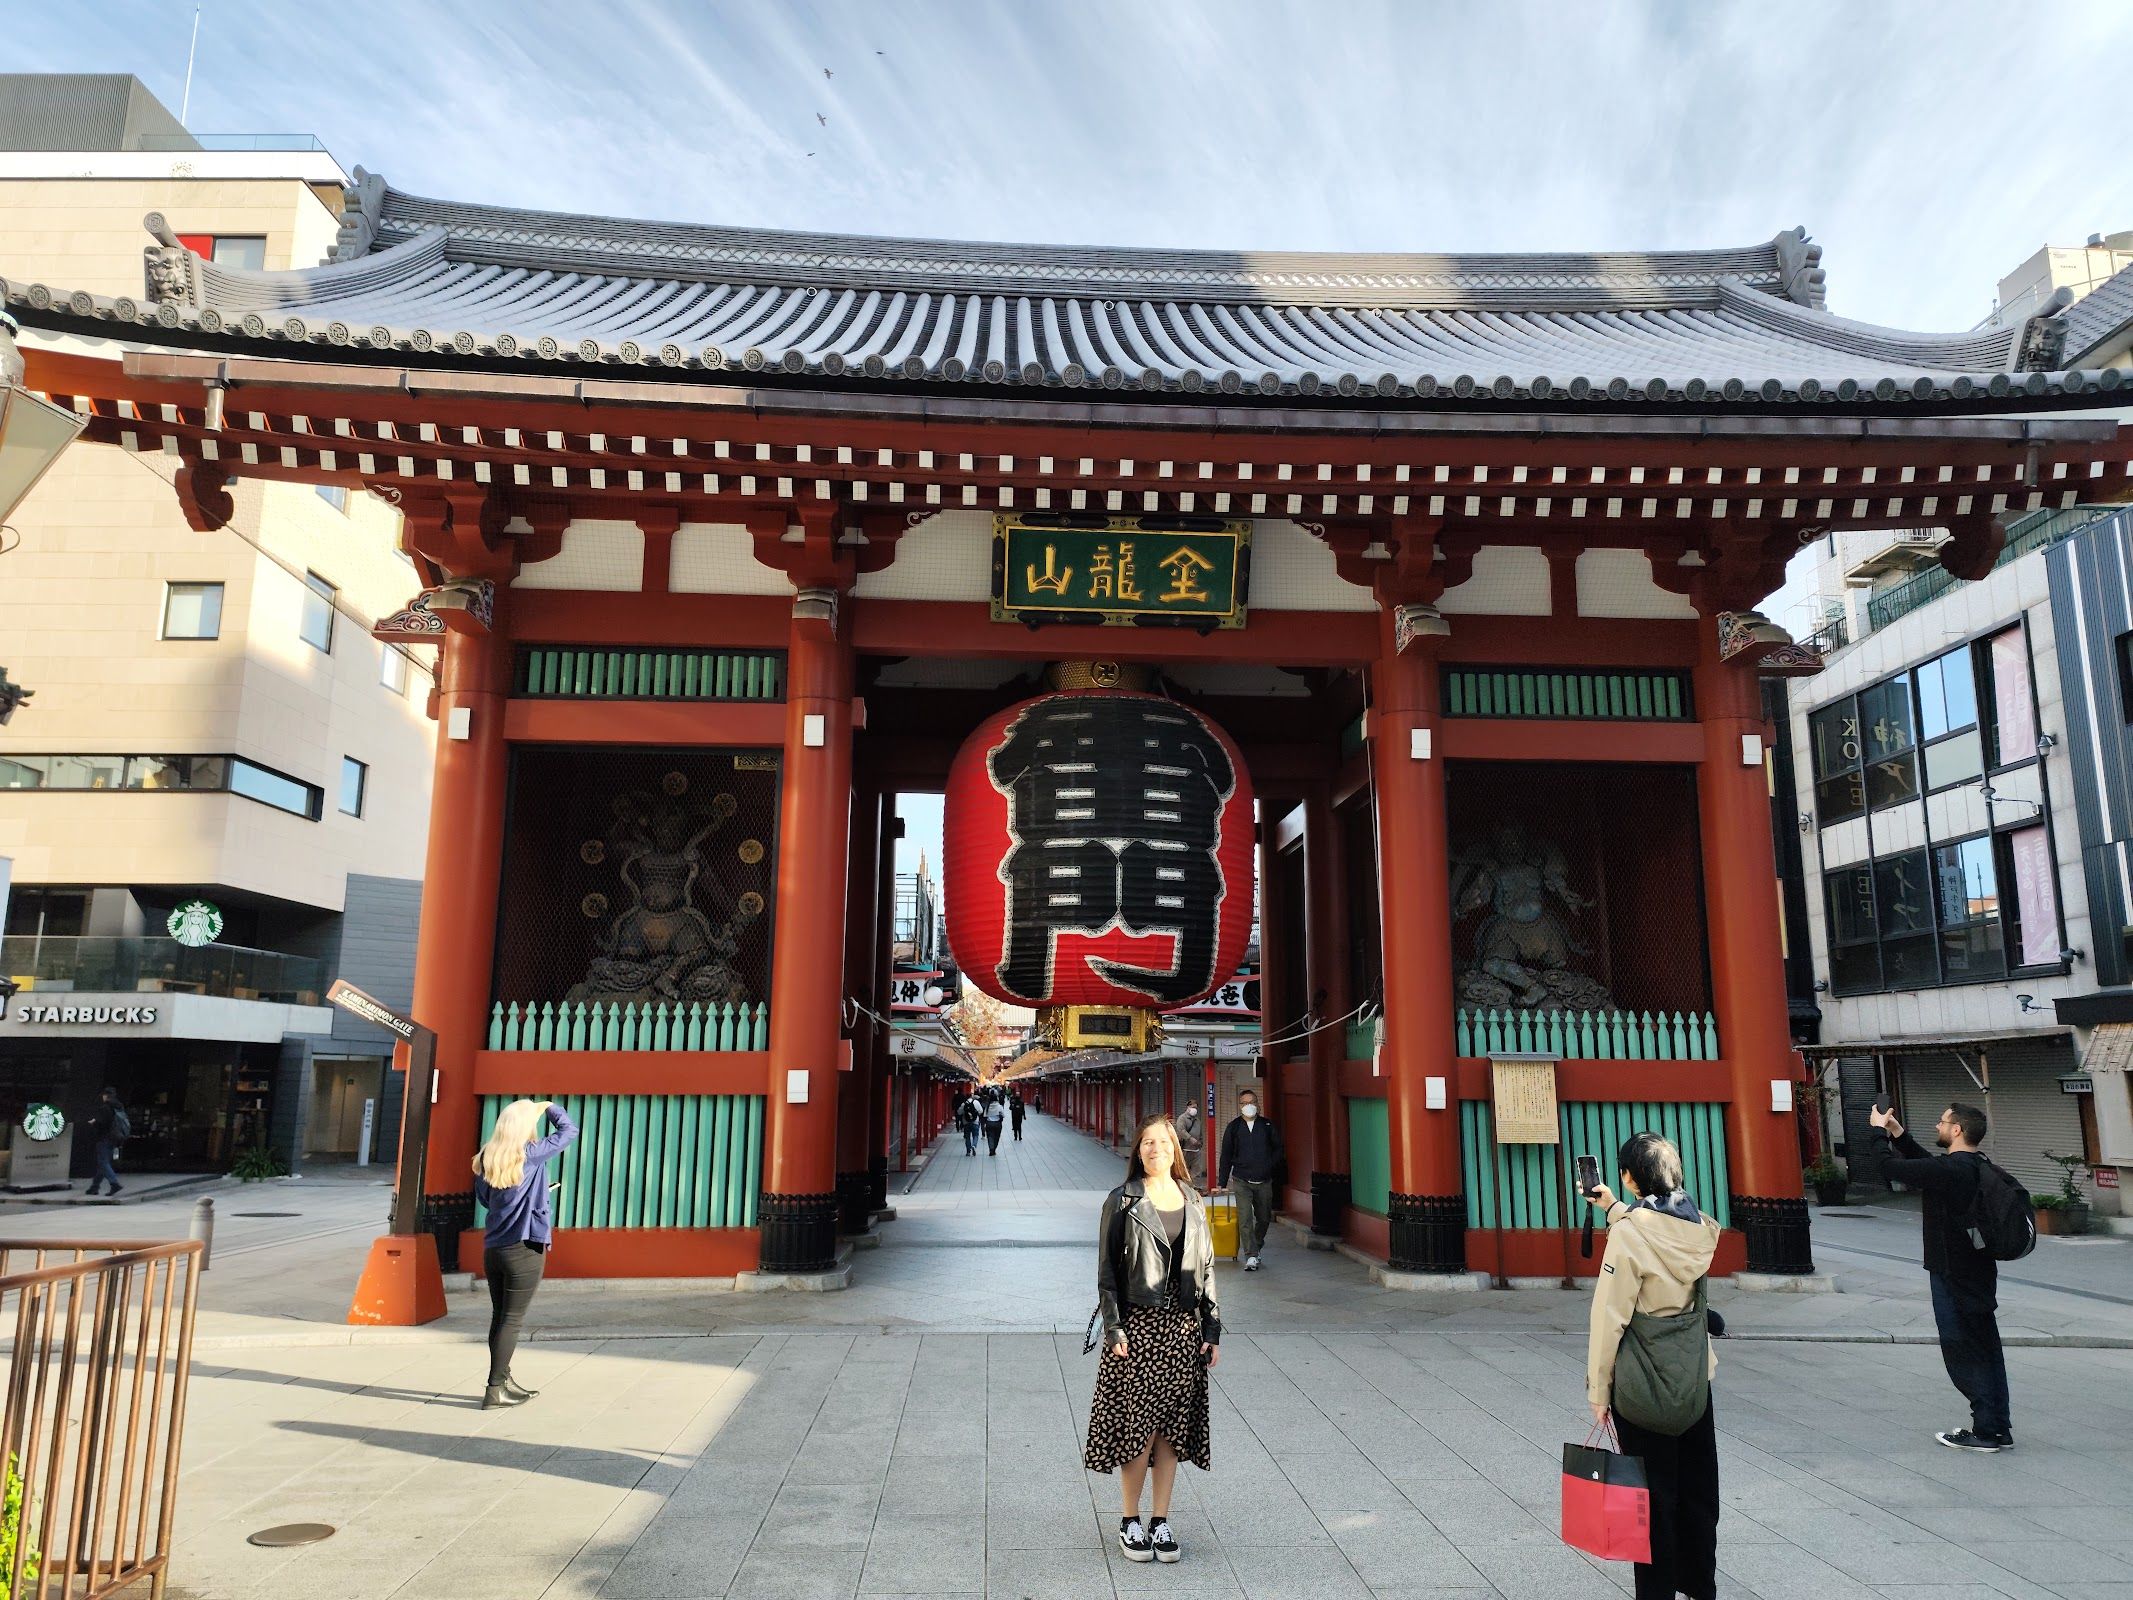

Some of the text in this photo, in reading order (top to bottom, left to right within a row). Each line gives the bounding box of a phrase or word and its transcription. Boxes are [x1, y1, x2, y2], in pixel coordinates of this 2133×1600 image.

[985, 692, 1238, 1003] 雷門
[17, 1006, 157, 1024] STARBUCKS
[341, 989, 395, 1024] KAMINARIMON
[393, 1018, 415, 1034] GATE
